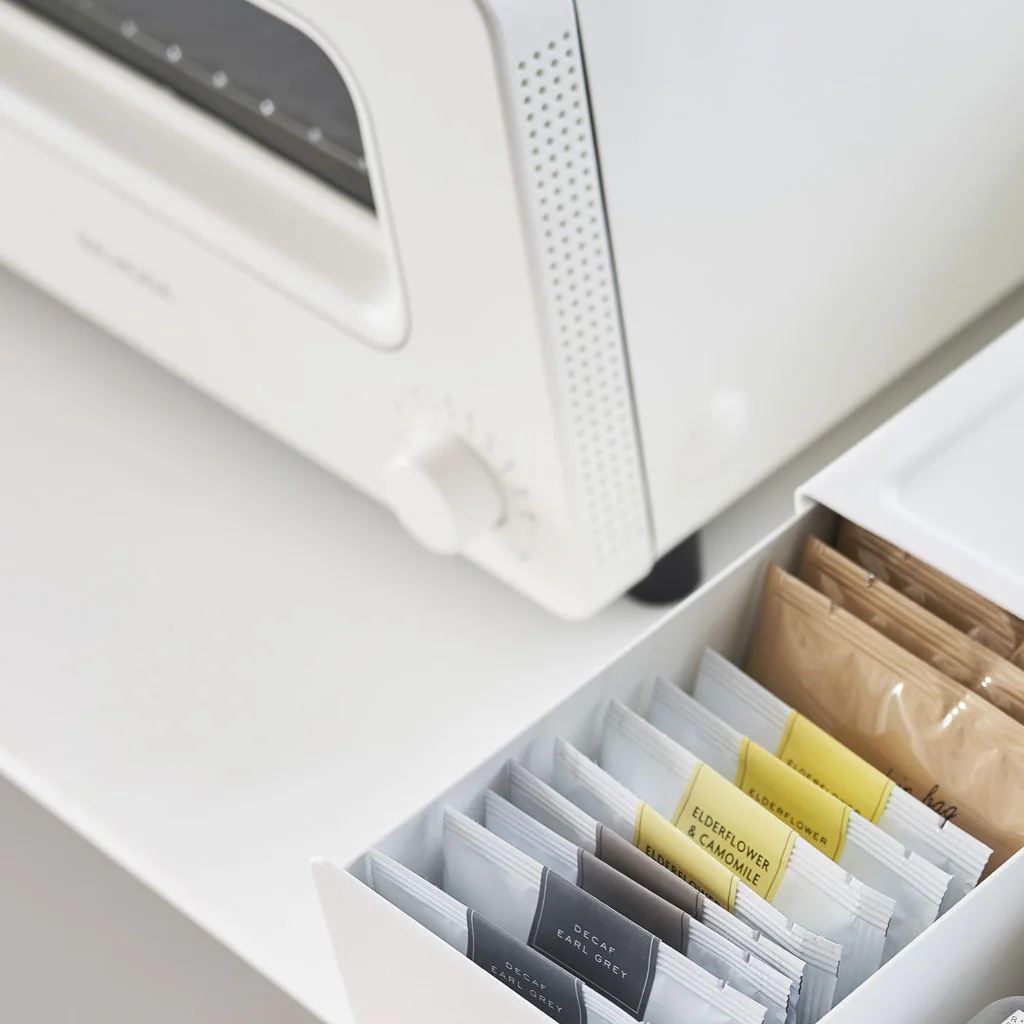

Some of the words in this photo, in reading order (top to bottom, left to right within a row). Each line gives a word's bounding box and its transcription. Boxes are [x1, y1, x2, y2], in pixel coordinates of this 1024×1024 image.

[692, 806, 770, 872] ELDERFLOWER
[748, 787, 828, 846] ELDERFLOWER
[687, 825, 697, 839] &
[699, 833, 761, 886] CAMOMILE
[556, 929, 588, 955] EARL
[594, 954, 628, 979] GREY
[574, 924, 616, 954] DECAF
[491, 965, 523, 990] EARL
[529, 989, 563, 1013] GREY
[505, 961, 547, 990] DECAF
